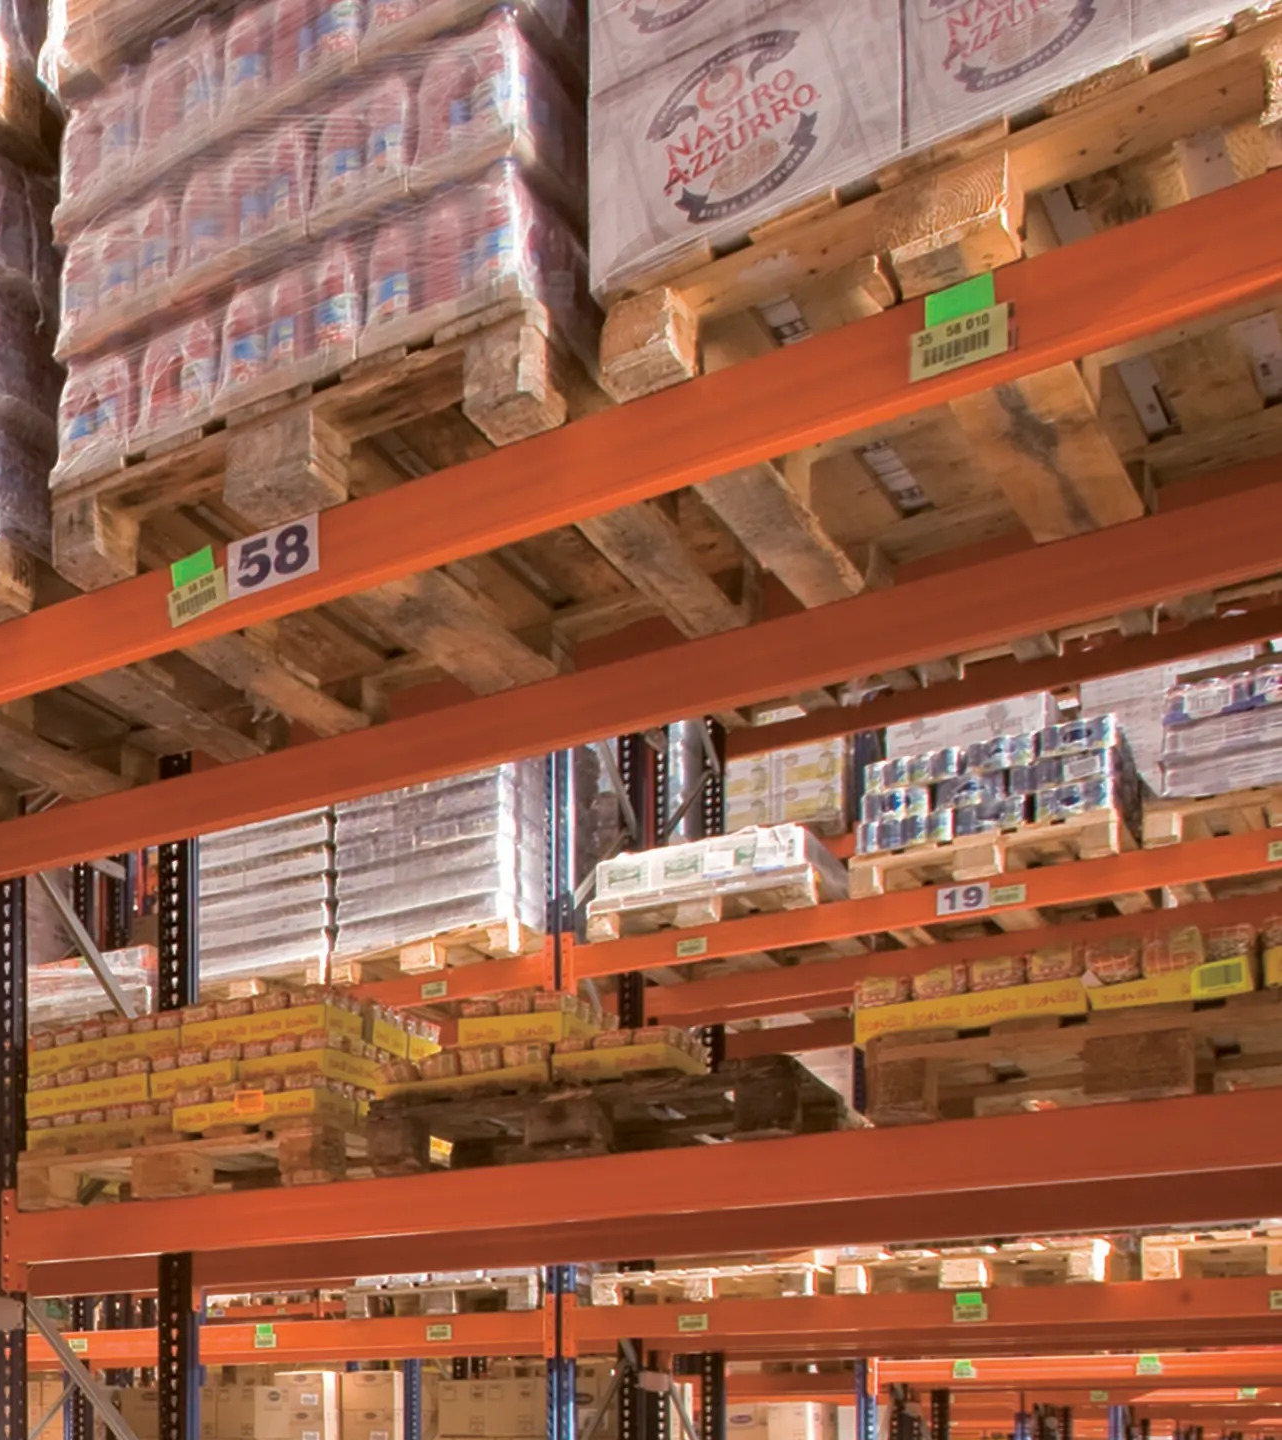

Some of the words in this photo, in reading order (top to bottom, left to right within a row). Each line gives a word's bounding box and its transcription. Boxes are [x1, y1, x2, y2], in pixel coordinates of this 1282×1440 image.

[663, 83, 818, 196] AZZURRO
[665, 68, 796, 166] NASTRO
[237, 524, 310, 588] 58
[943, 885, 983, 911] 19
